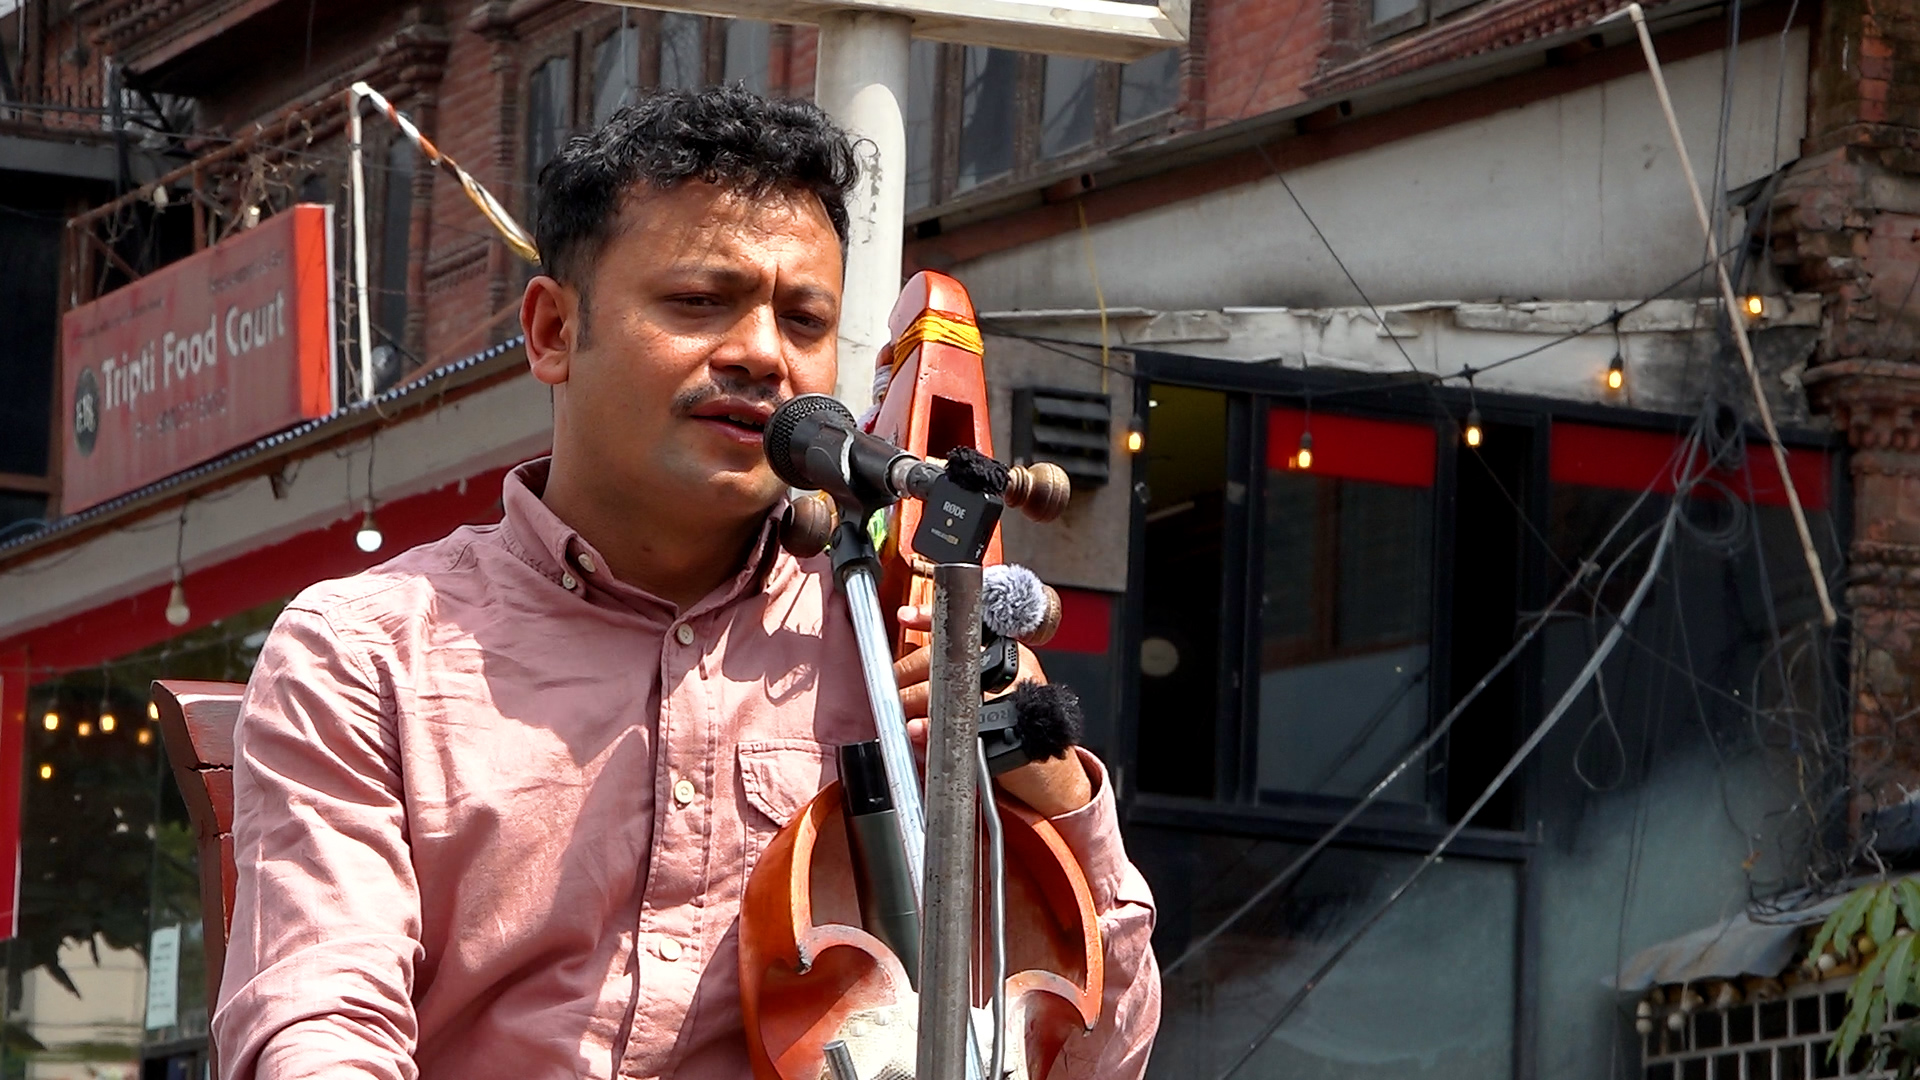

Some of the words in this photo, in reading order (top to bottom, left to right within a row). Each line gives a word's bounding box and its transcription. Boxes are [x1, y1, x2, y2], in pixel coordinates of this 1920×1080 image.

[101, 342, 155, 412] Tripti
[163, 314, 218, 390] Food
[226, 291, 285, 357] Court
